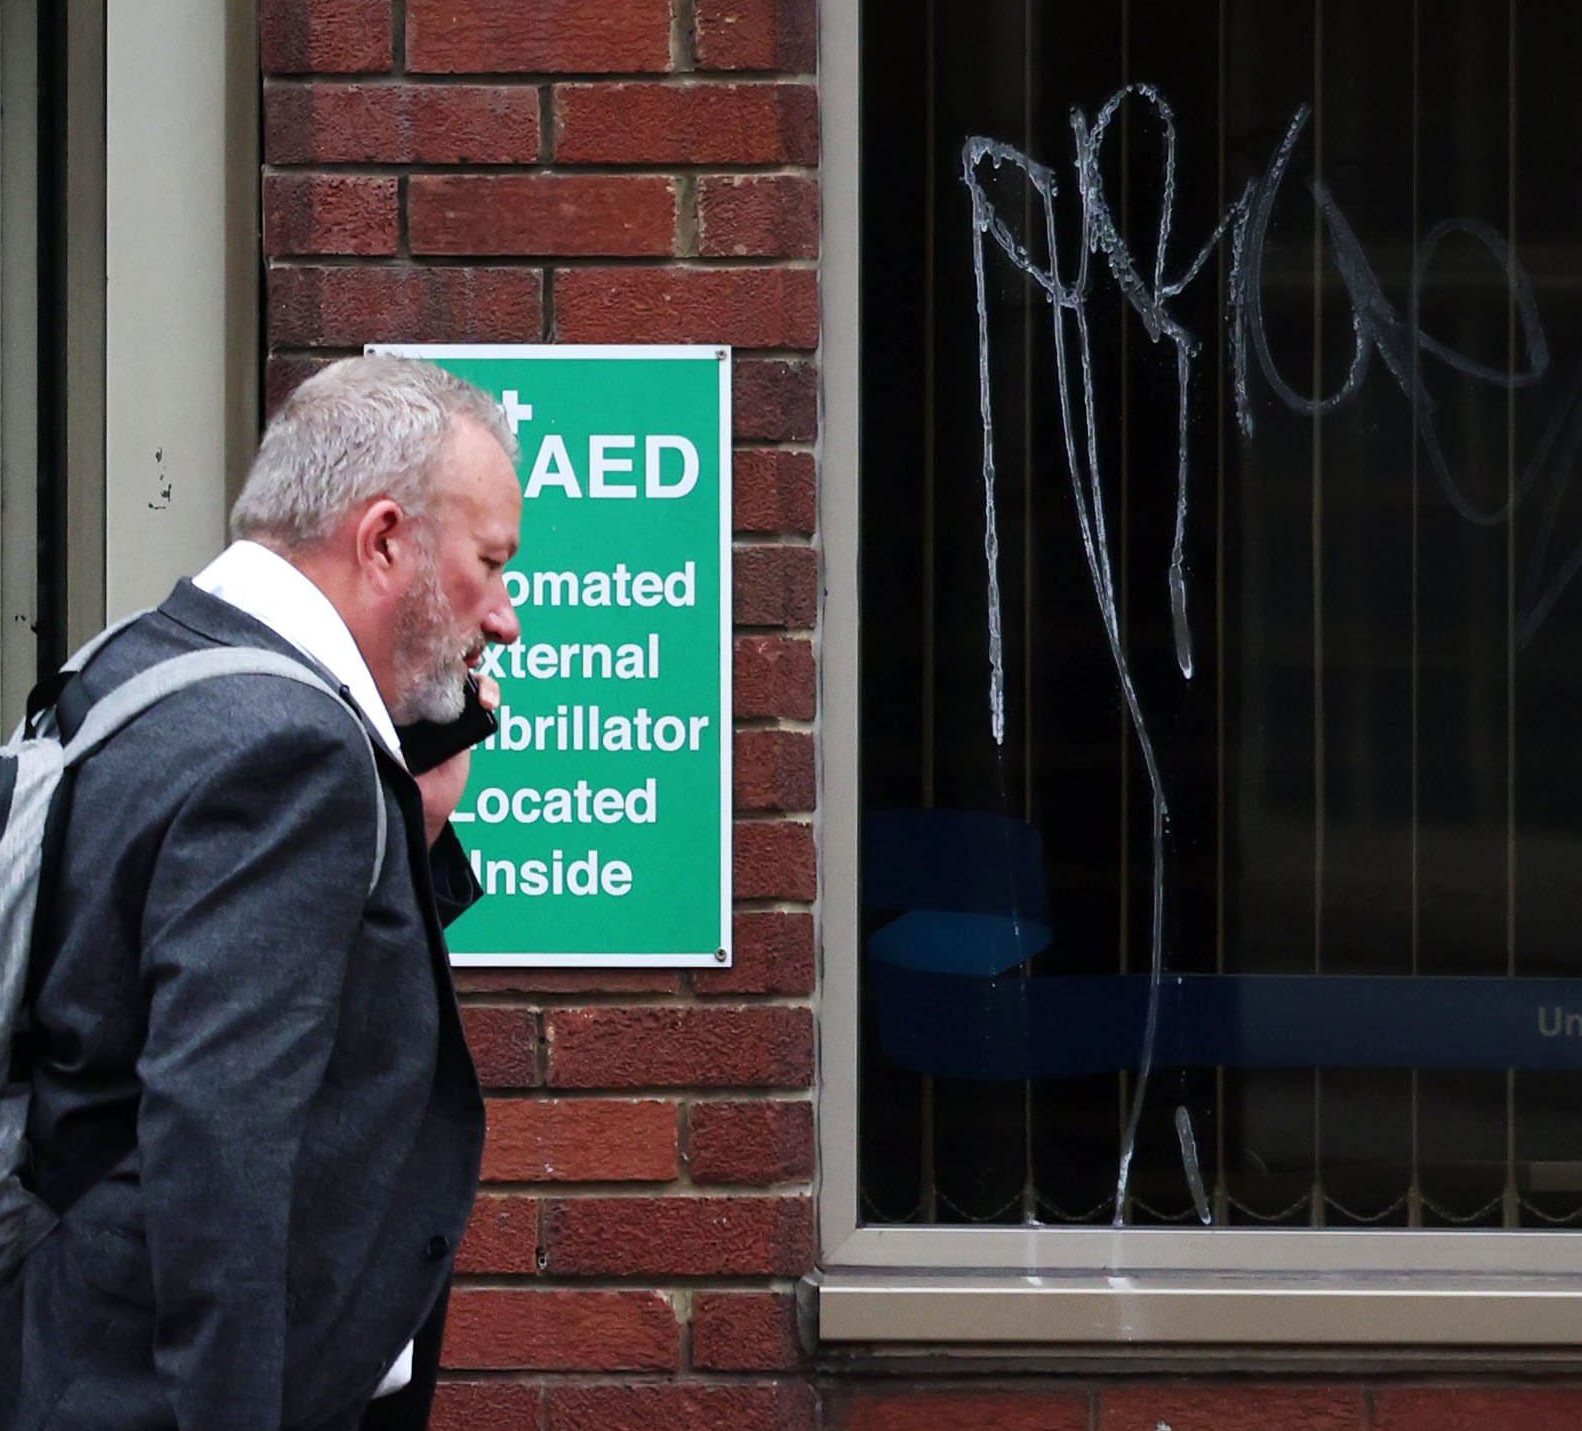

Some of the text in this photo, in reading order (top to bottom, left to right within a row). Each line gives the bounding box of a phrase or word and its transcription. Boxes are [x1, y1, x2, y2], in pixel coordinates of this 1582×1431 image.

[523, 434, 699, 499] AED
[501, 561, 695, 607] omated
[470, 634, 659, 679] xternal
[474, 705, 709, 751] brillator
[469, 849, 633, 896] Inside
